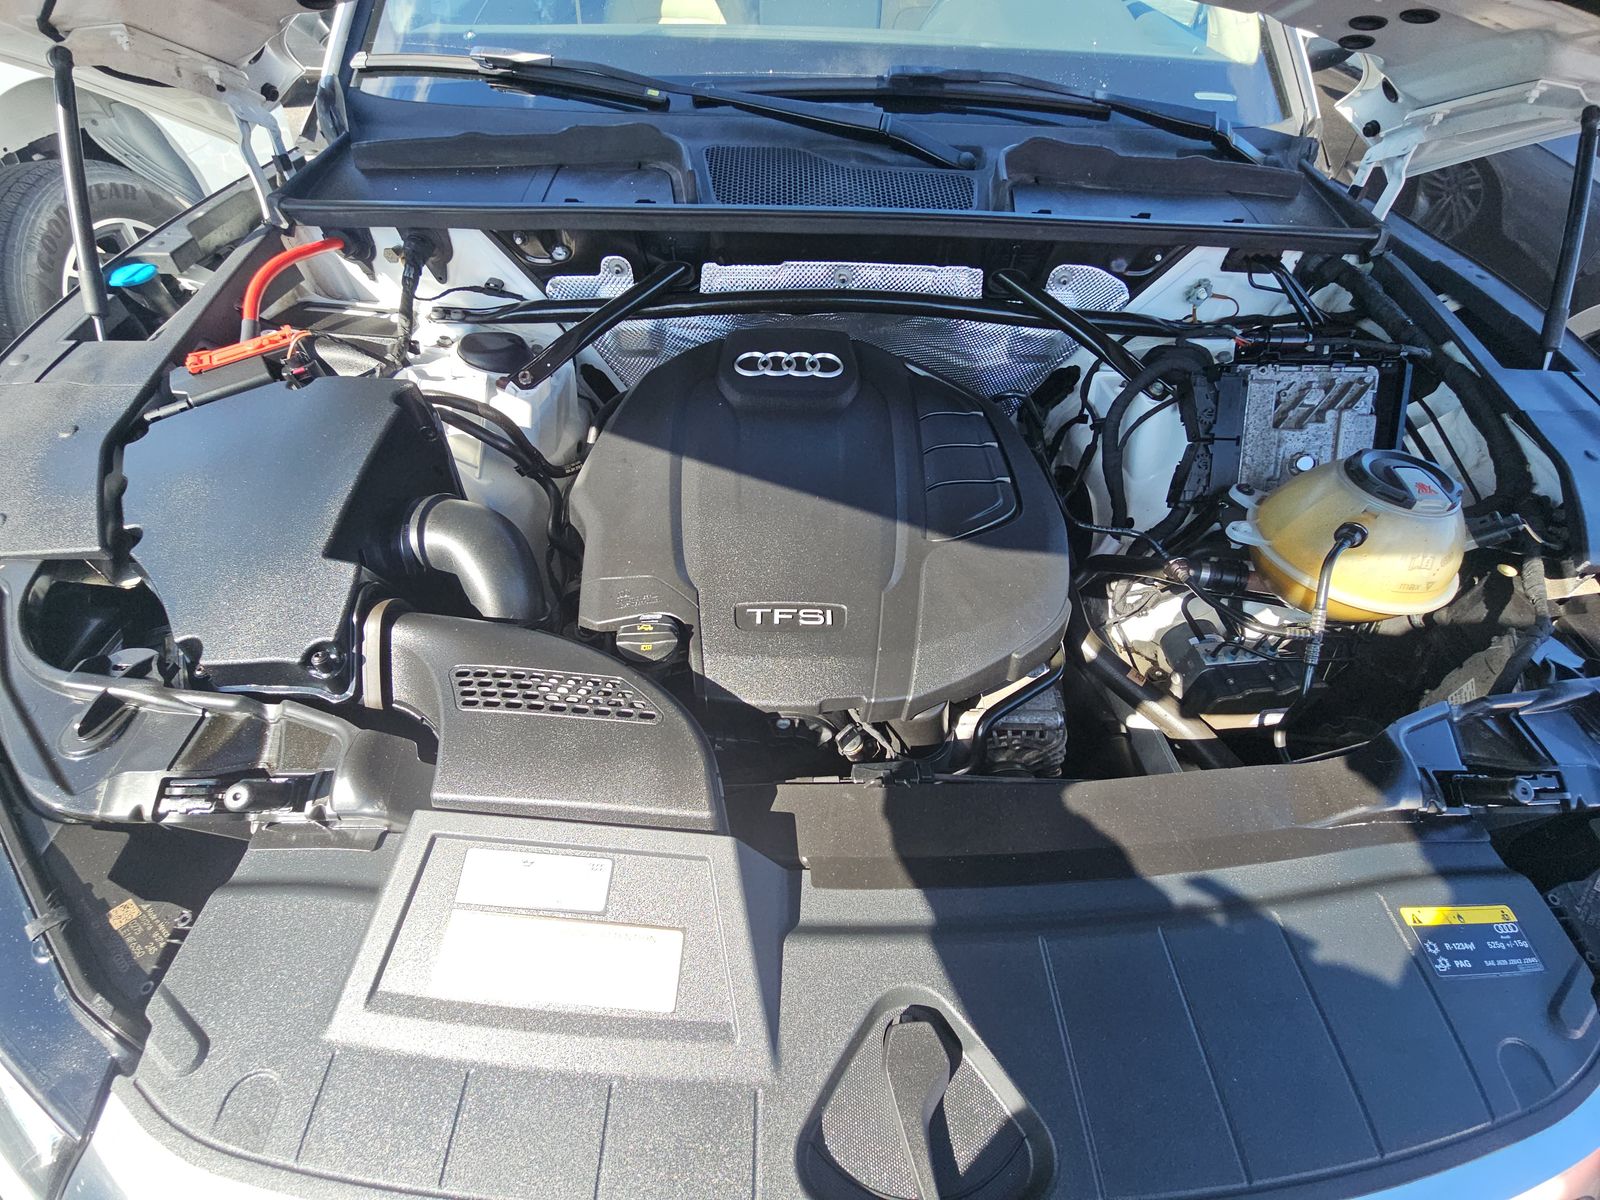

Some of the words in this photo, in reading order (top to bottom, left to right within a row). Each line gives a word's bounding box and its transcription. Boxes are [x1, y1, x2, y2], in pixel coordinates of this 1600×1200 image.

[746, 608, 834, 626] TFSI
[1487, 941, 1506, 949] 525g
[1454, 960, 1472, 968] PAG
